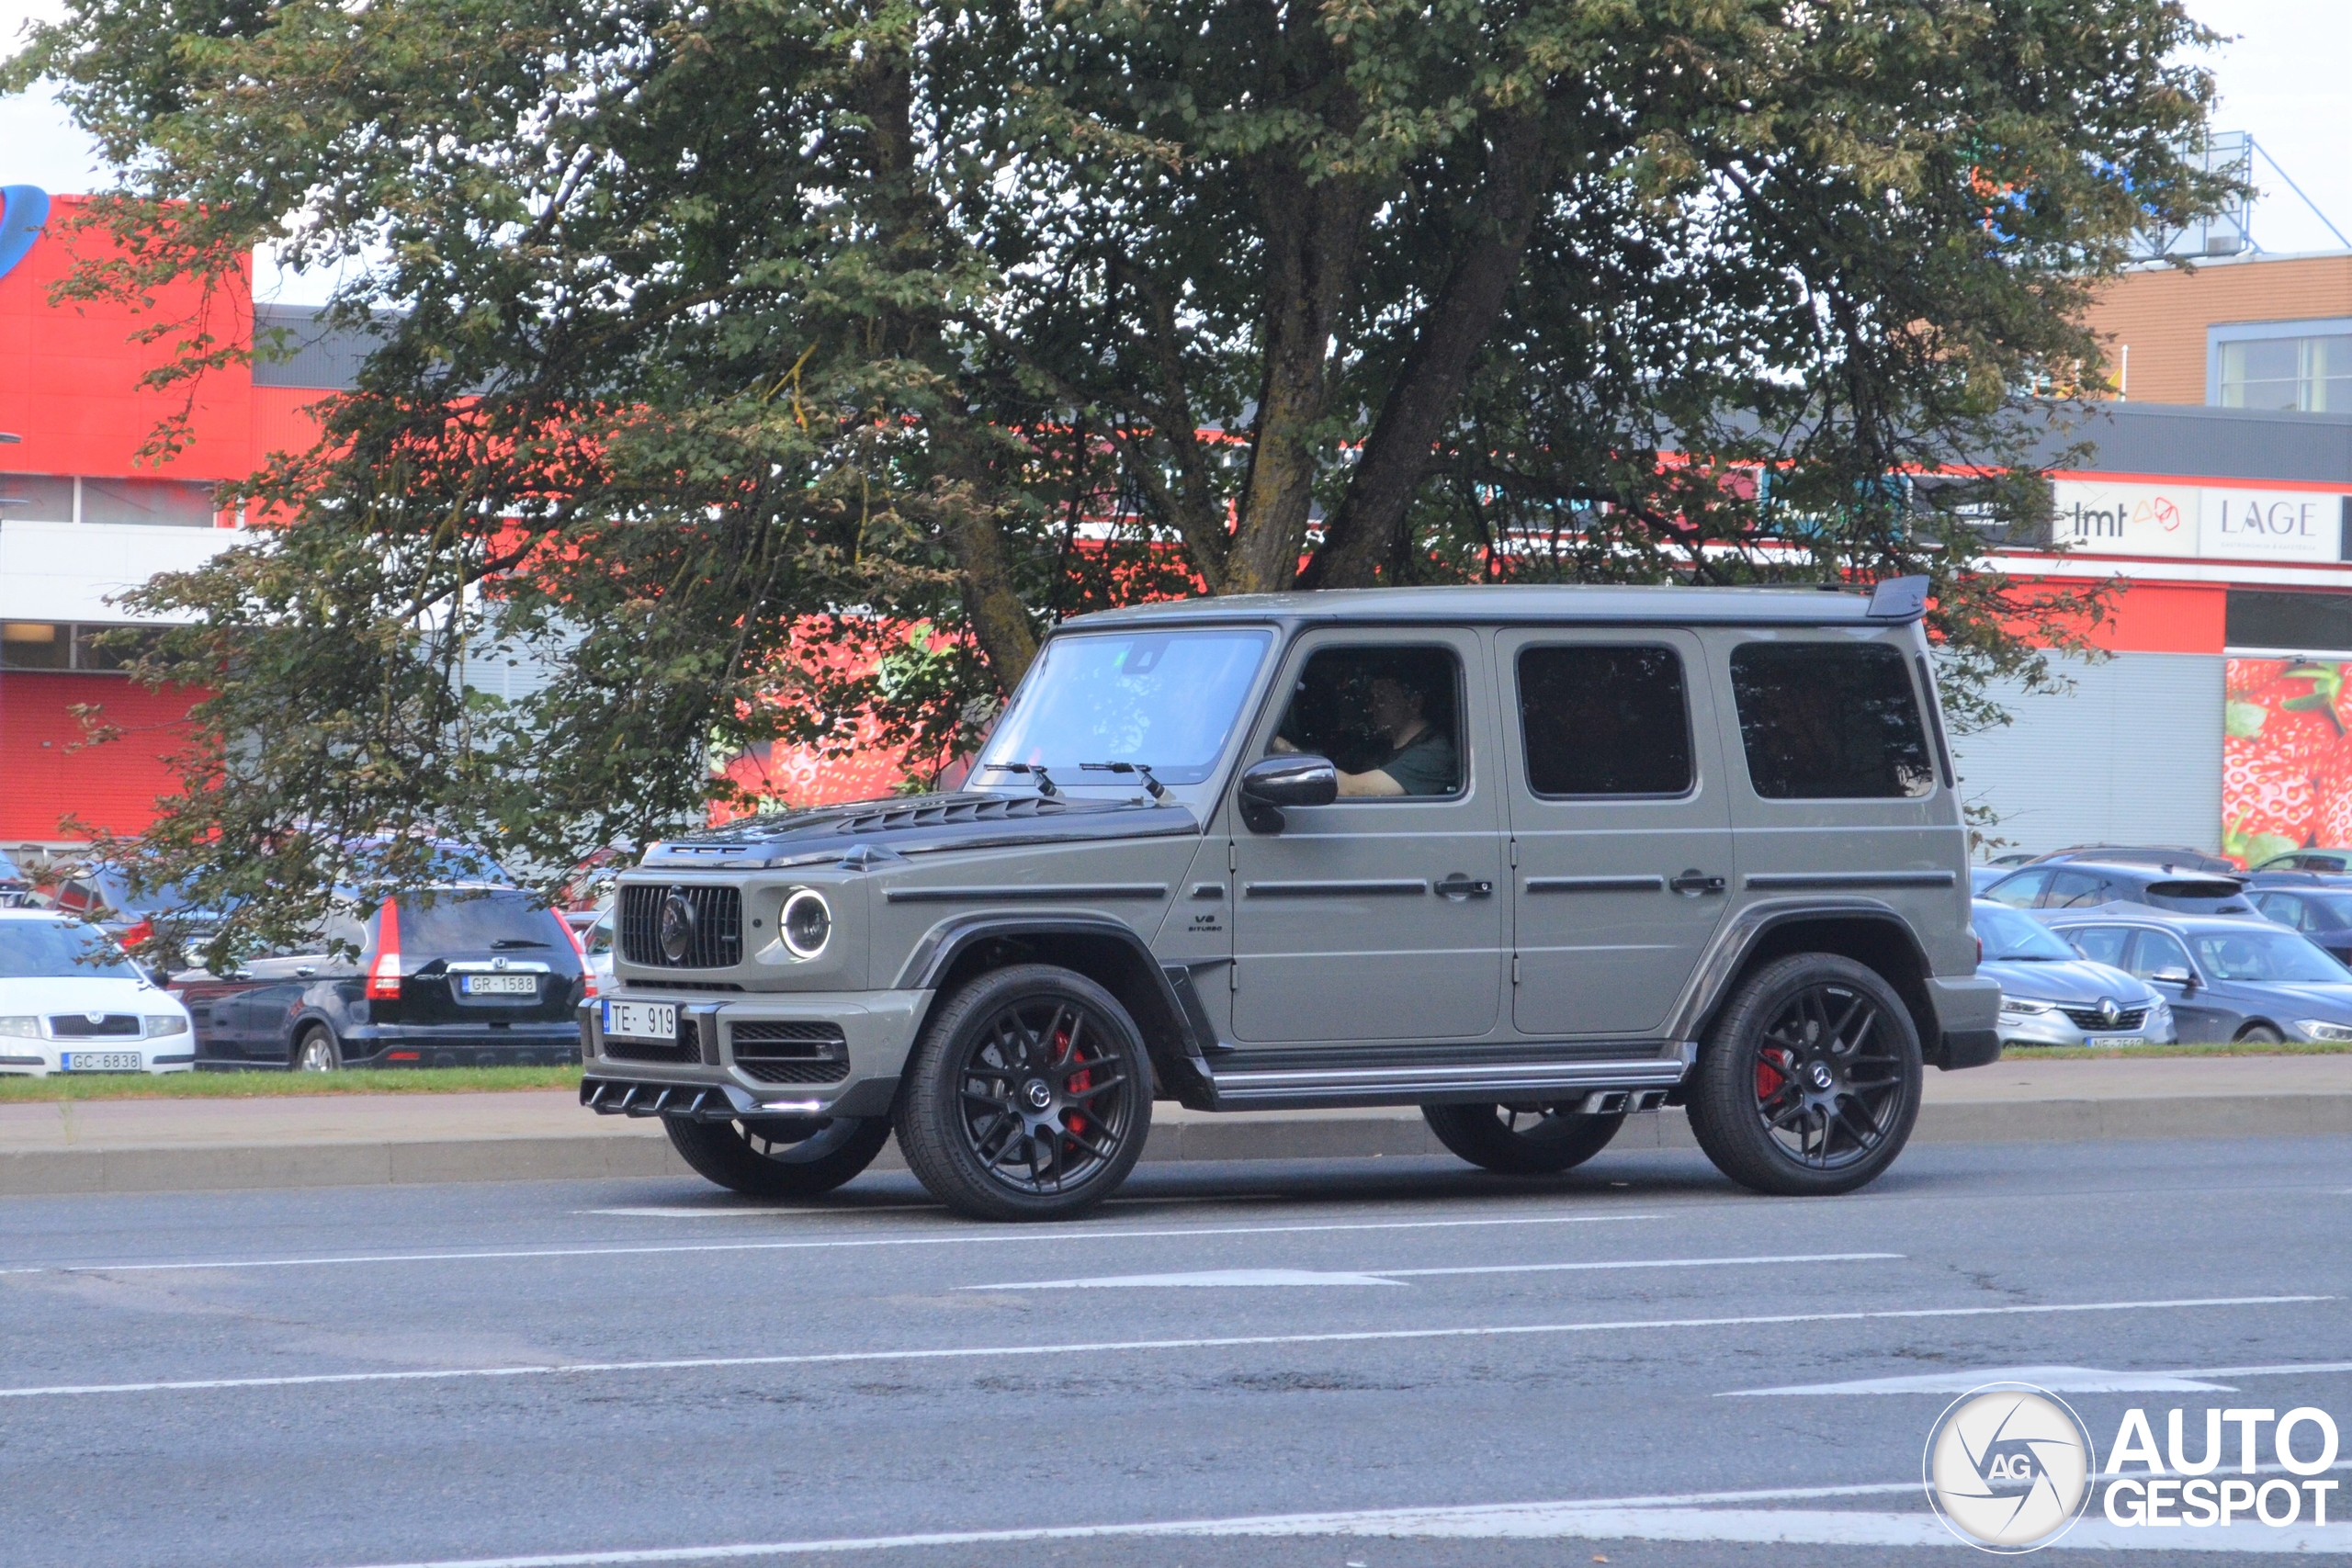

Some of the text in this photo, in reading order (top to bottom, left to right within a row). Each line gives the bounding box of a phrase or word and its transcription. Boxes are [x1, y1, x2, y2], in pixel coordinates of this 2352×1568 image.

[2075, 502, 2128, 536] lmt
[2222, 500, 2317, 536] LAGE
[1194, 915, 1215, 923] V8
[472, 977, 533, 991] GR-1588
[648, 1007, 674, 1034] 919
[74, 1055, 138, 1068] GC-6838
